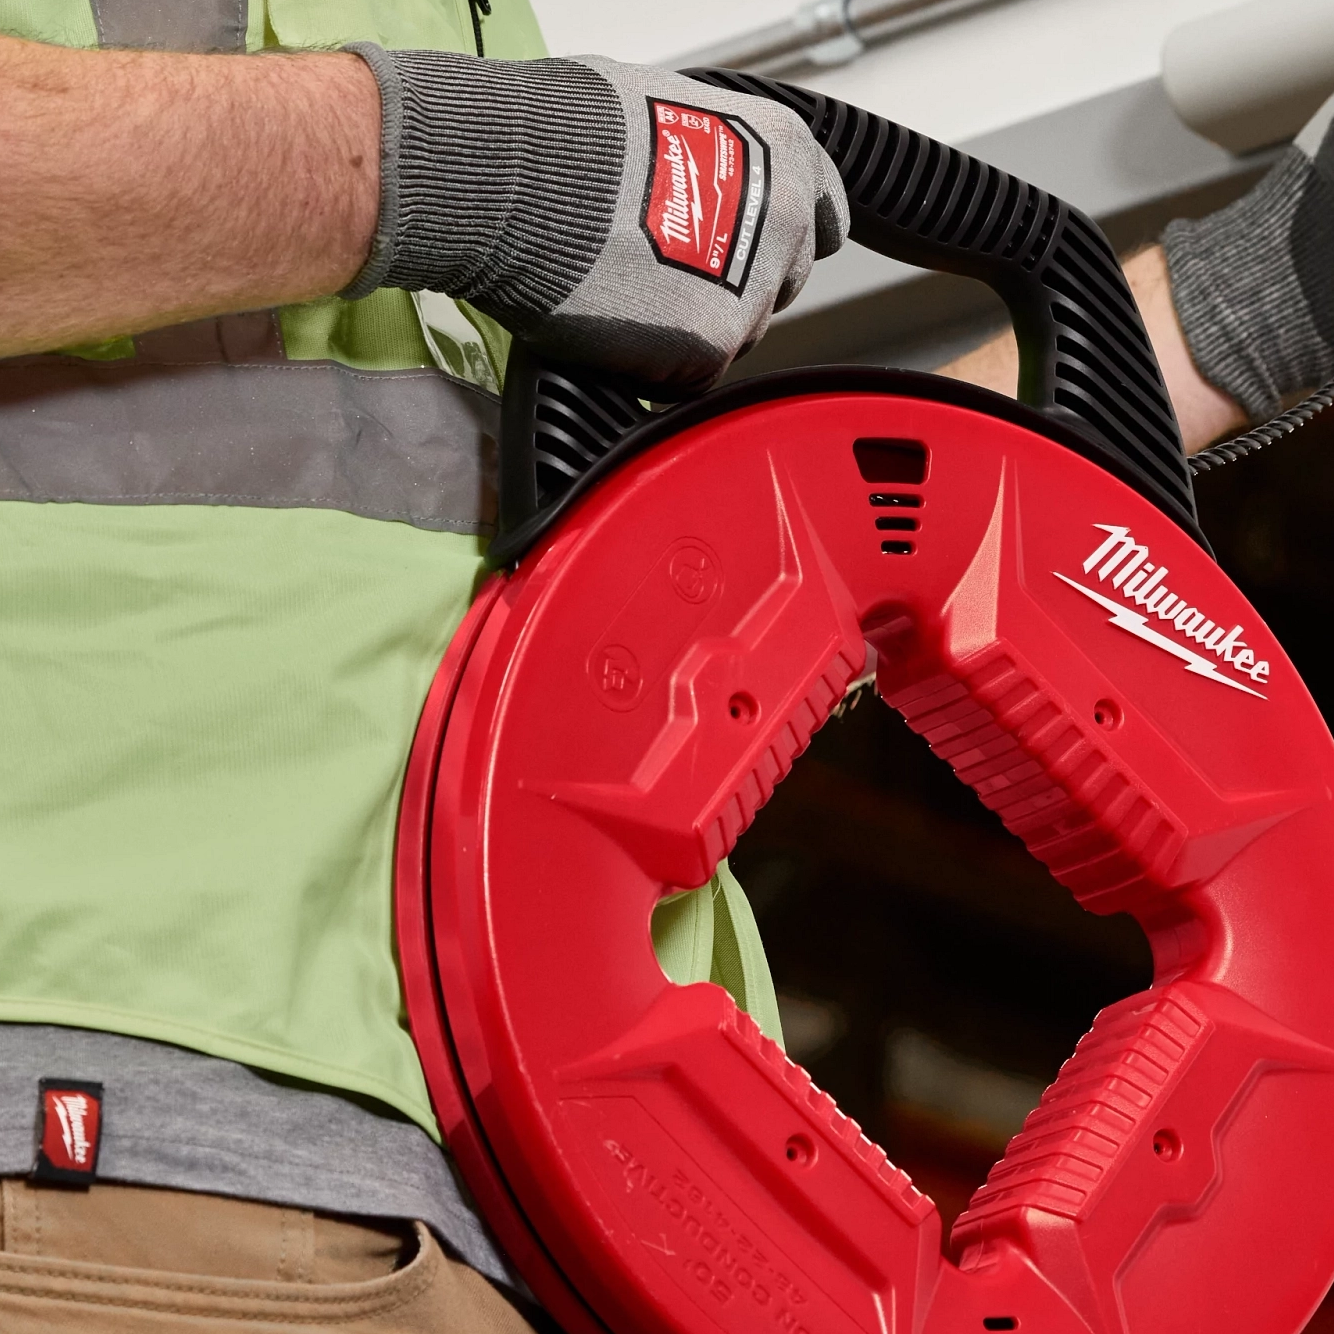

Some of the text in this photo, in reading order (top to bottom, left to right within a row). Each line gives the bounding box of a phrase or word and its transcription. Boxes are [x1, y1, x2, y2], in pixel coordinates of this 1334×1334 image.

[736, 165, 762, 261] CUT LEVEL 4
[1082, 523, 1270, 684] Milwaukee
[60, 1094, 91, 1164] Milwaukee
[612, 1143, 774, 1306] CONDUCTIVE
